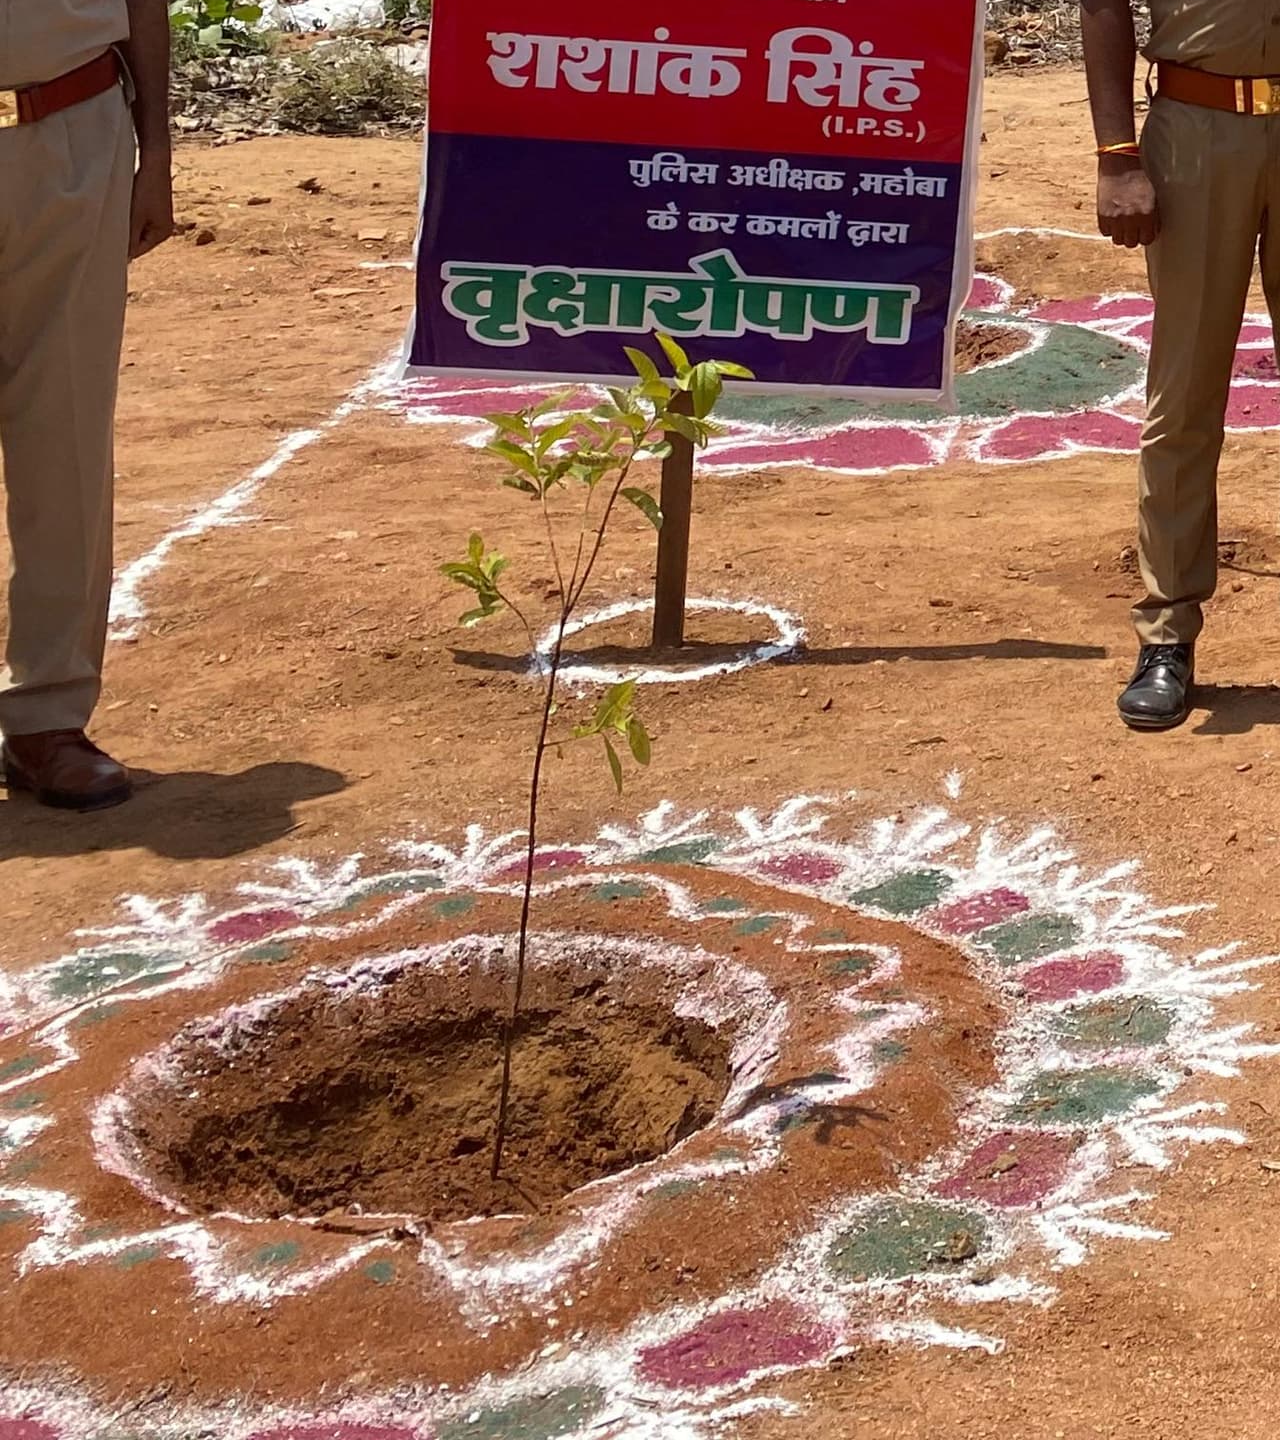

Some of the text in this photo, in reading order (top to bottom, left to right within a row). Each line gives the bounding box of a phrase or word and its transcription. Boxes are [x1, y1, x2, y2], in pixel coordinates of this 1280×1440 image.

[486, 26, 926, 112] शशांक सिंह
[822, 116, 927, 143] (I.P.S.)
[628, 152, 719, 187] पुलिस
[726, 158, 846, 191] अधीक्षक
[647, 201, 910, 248] के कर कमलों द्वारा
[441, 248, 920, 347] वृक्षारोपण
